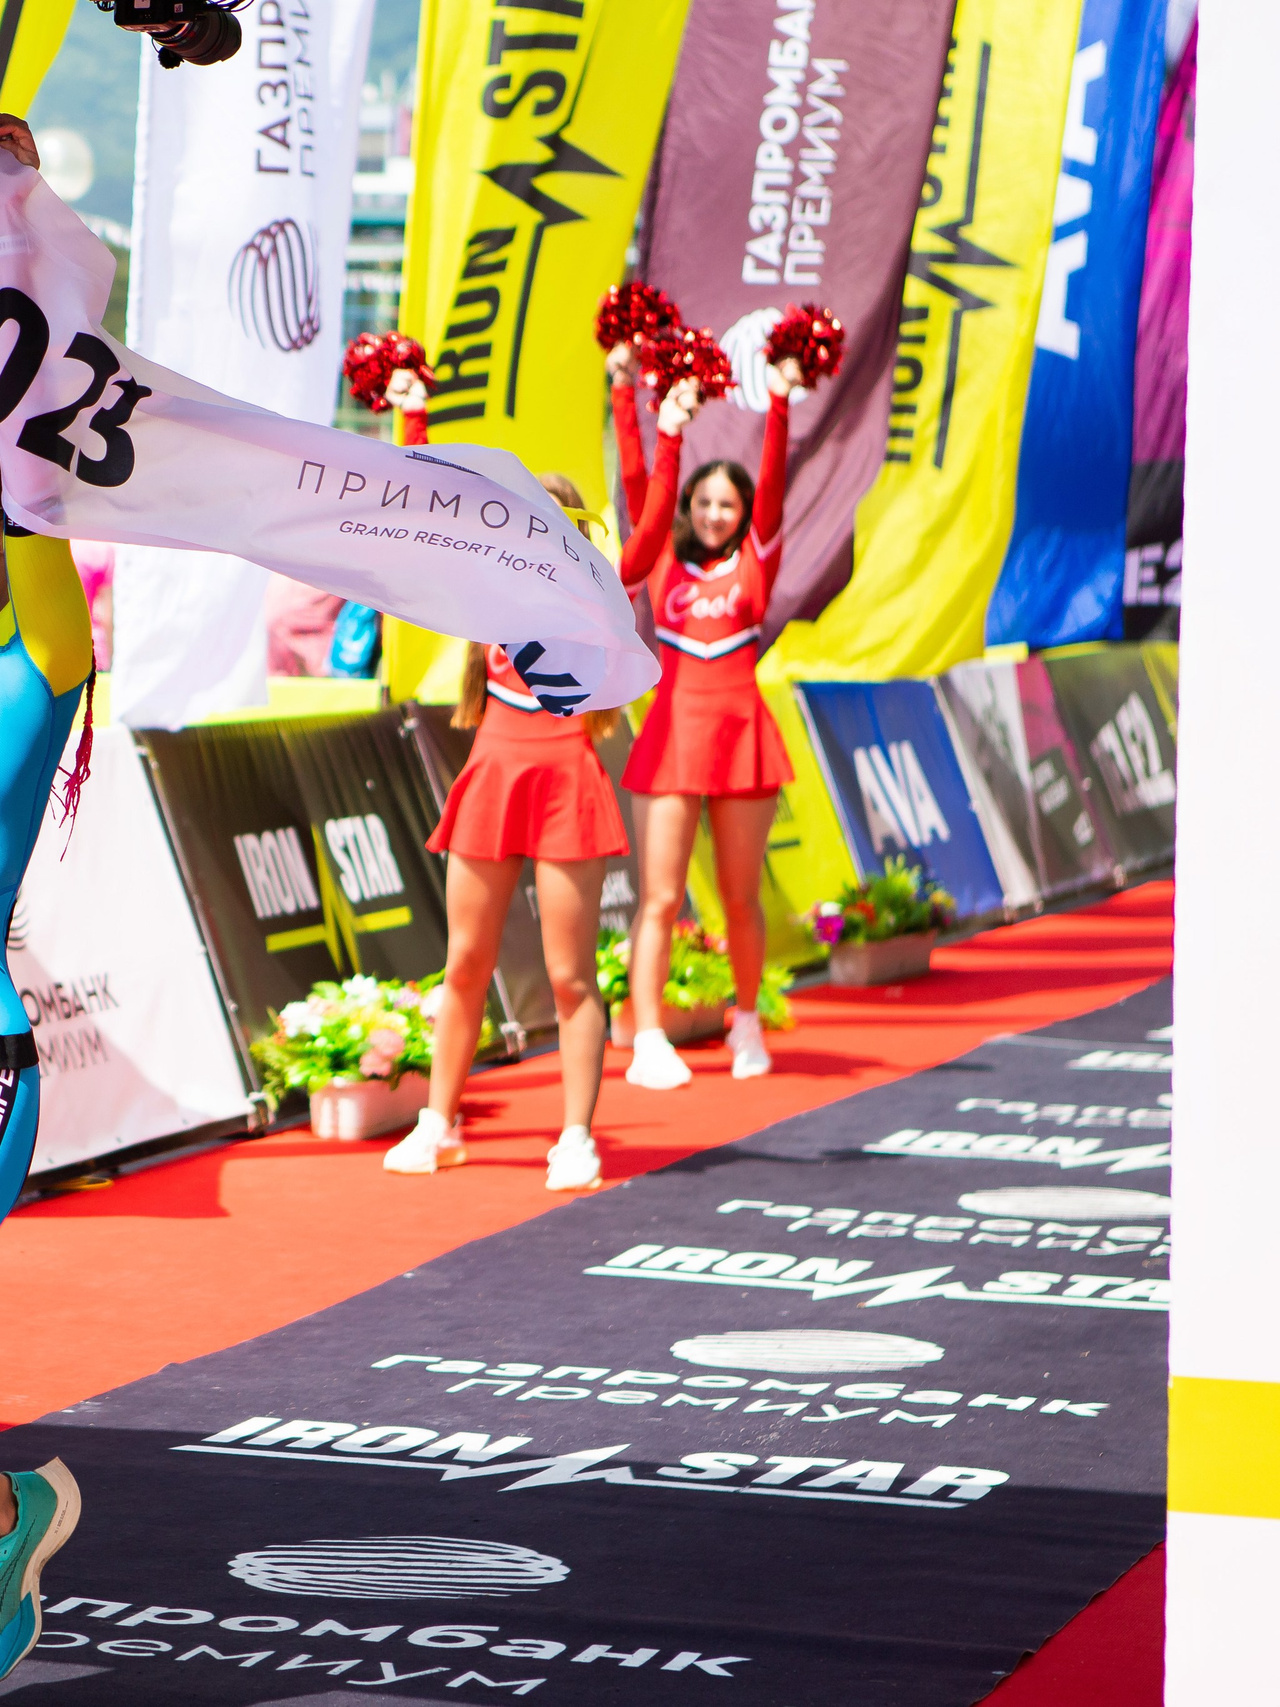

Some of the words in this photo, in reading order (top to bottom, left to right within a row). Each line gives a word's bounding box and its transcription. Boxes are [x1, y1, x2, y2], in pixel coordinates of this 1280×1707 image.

[783, 58, 850, 285] ПРЕМИУМ
[297, 460, 606, 591] ПРИМОРЬЕ
[339, 520, 409, 540] GRAND
[413, 531, 496, 557] RESORT
[854, 741, 951, 854] AVA
[233, 826, 319, 919] IRON
[325, 813, 404, 903] STAR
[20, 972, 120, 1027] ОМБАНК
[605, 1244, 874, 1283] IRON
[982, 1271, 1171, 1303] STA
[201, 1416, 534, 1463] IRON
[677, 1451, 1010, 1501] STAR
